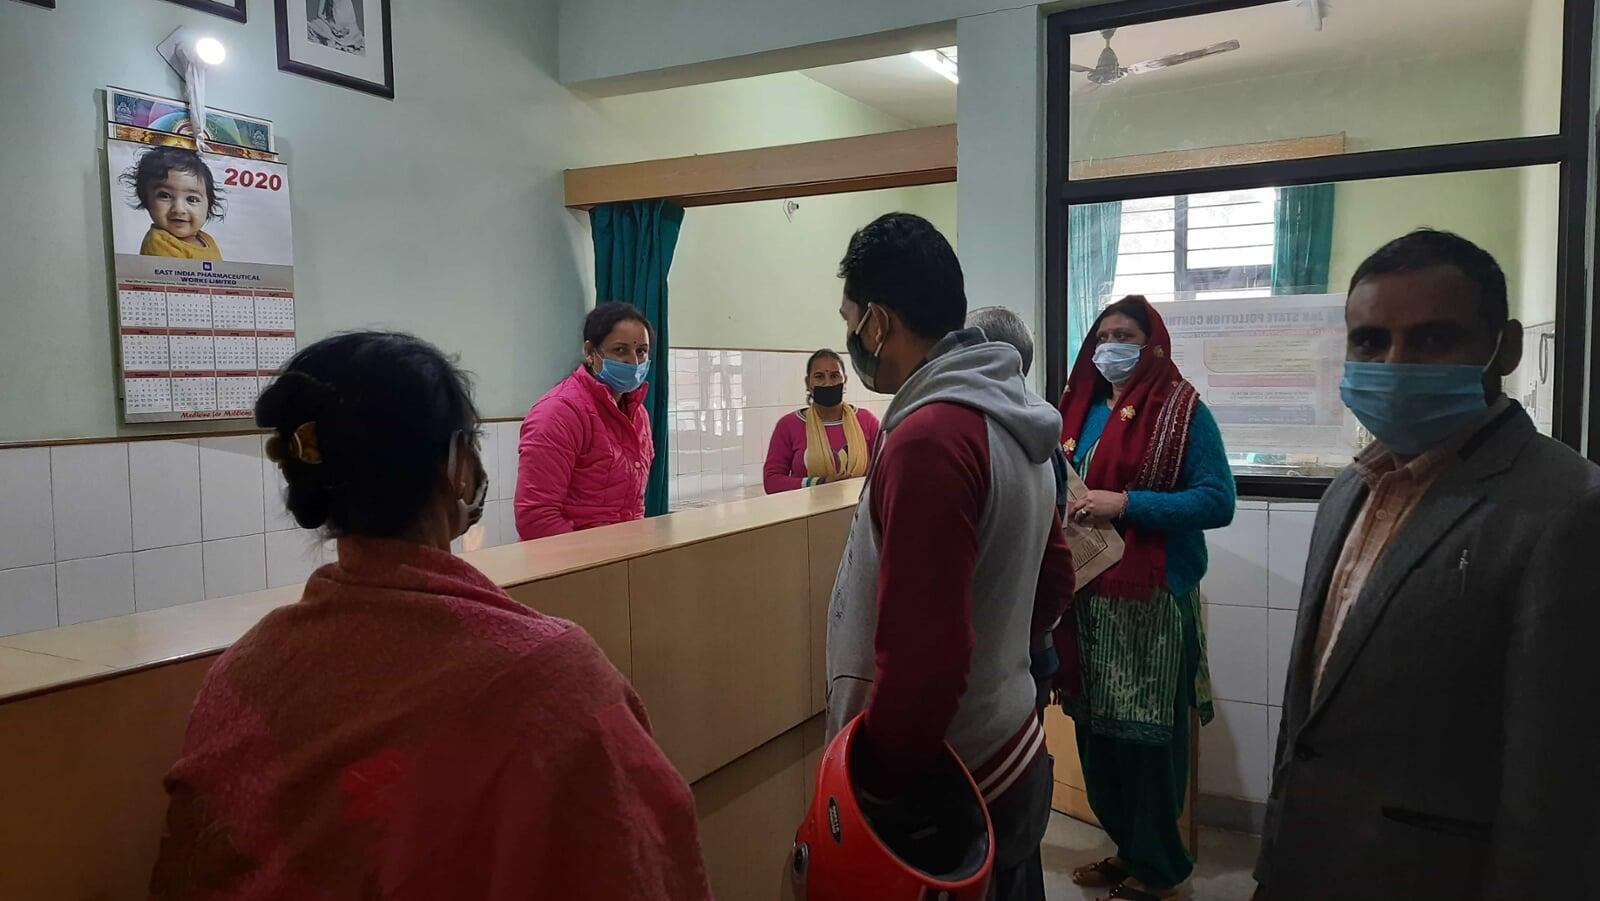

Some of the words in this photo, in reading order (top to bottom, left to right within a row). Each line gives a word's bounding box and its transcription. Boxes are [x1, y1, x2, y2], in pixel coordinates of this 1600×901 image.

[224, 167, 282, 191] 2020
[180, 276, 208, 284] WORKS
[197, 271, 260, 281] PHARMACEUTICAL
